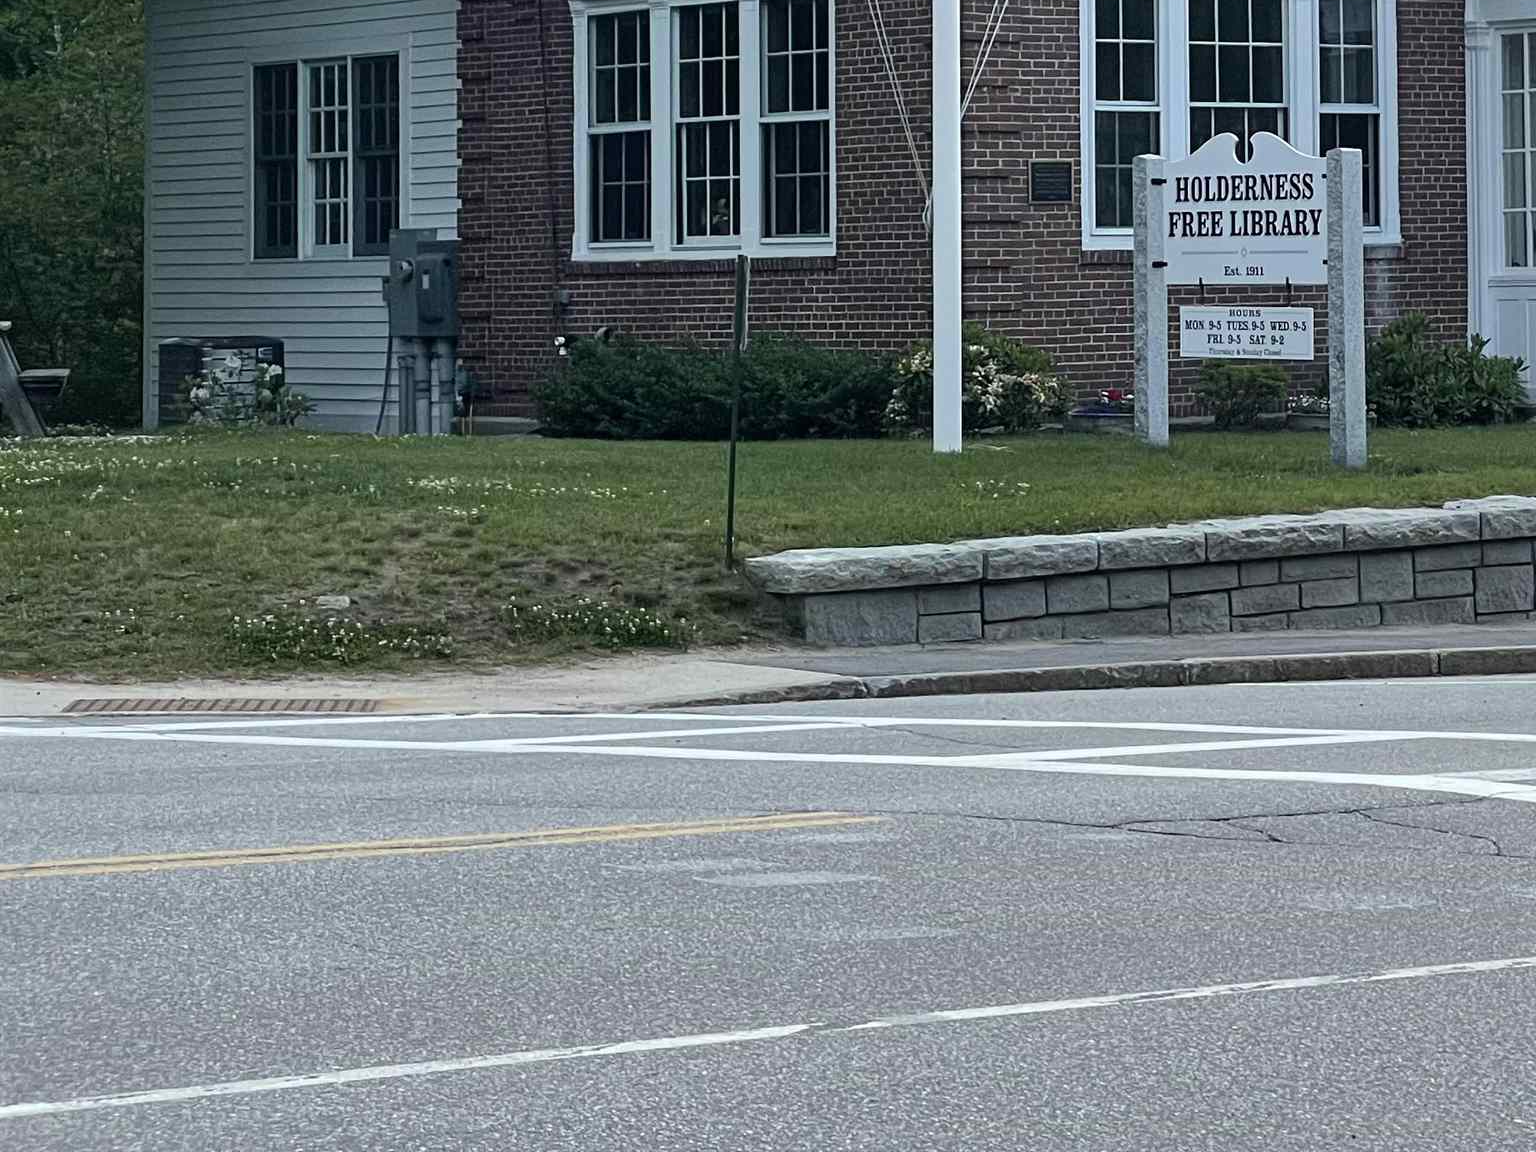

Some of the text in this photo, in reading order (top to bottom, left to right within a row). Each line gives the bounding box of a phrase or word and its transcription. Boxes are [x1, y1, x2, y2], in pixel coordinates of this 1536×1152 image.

[1175, 173, 1314, 203] HOLDERNESS
[1168, 209, 1322, 238] FREE LIBRARY
[1224, 265, 1264, 276] Est. 1911
[1229, 309, 1261, 317] HOURS
[1270, 335, 1285, 345] 9-2
